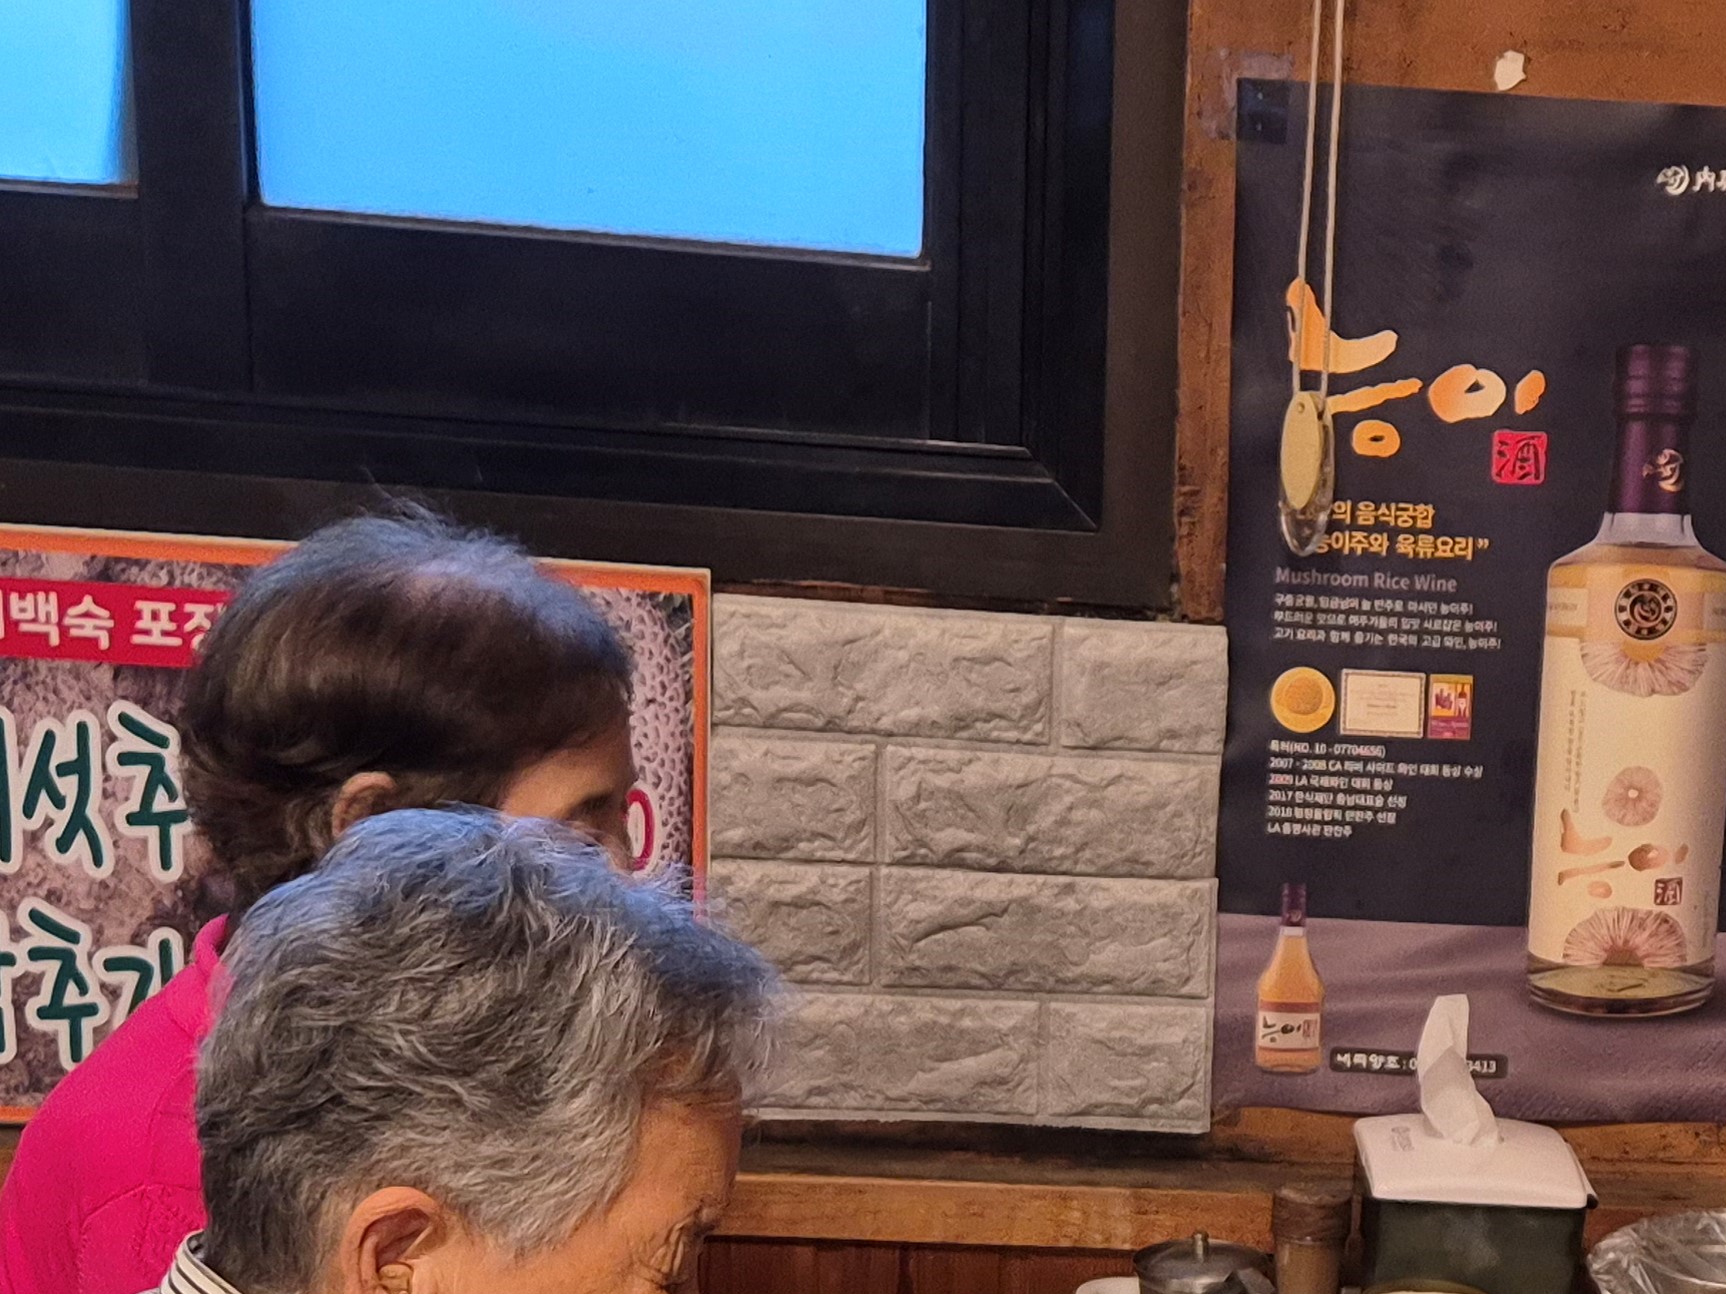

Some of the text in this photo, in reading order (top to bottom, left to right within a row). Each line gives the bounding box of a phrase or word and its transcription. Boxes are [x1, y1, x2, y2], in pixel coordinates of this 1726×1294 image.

[1356, 501, 1436, 529] 음식궁합
[1275, 566, 1458, 592] Mushroom Rice Wine
[0, 589, 114, 650] 백숙
[1273, 626, 1294, 640] 고기
[0, 711, 190, 871] 섯추
